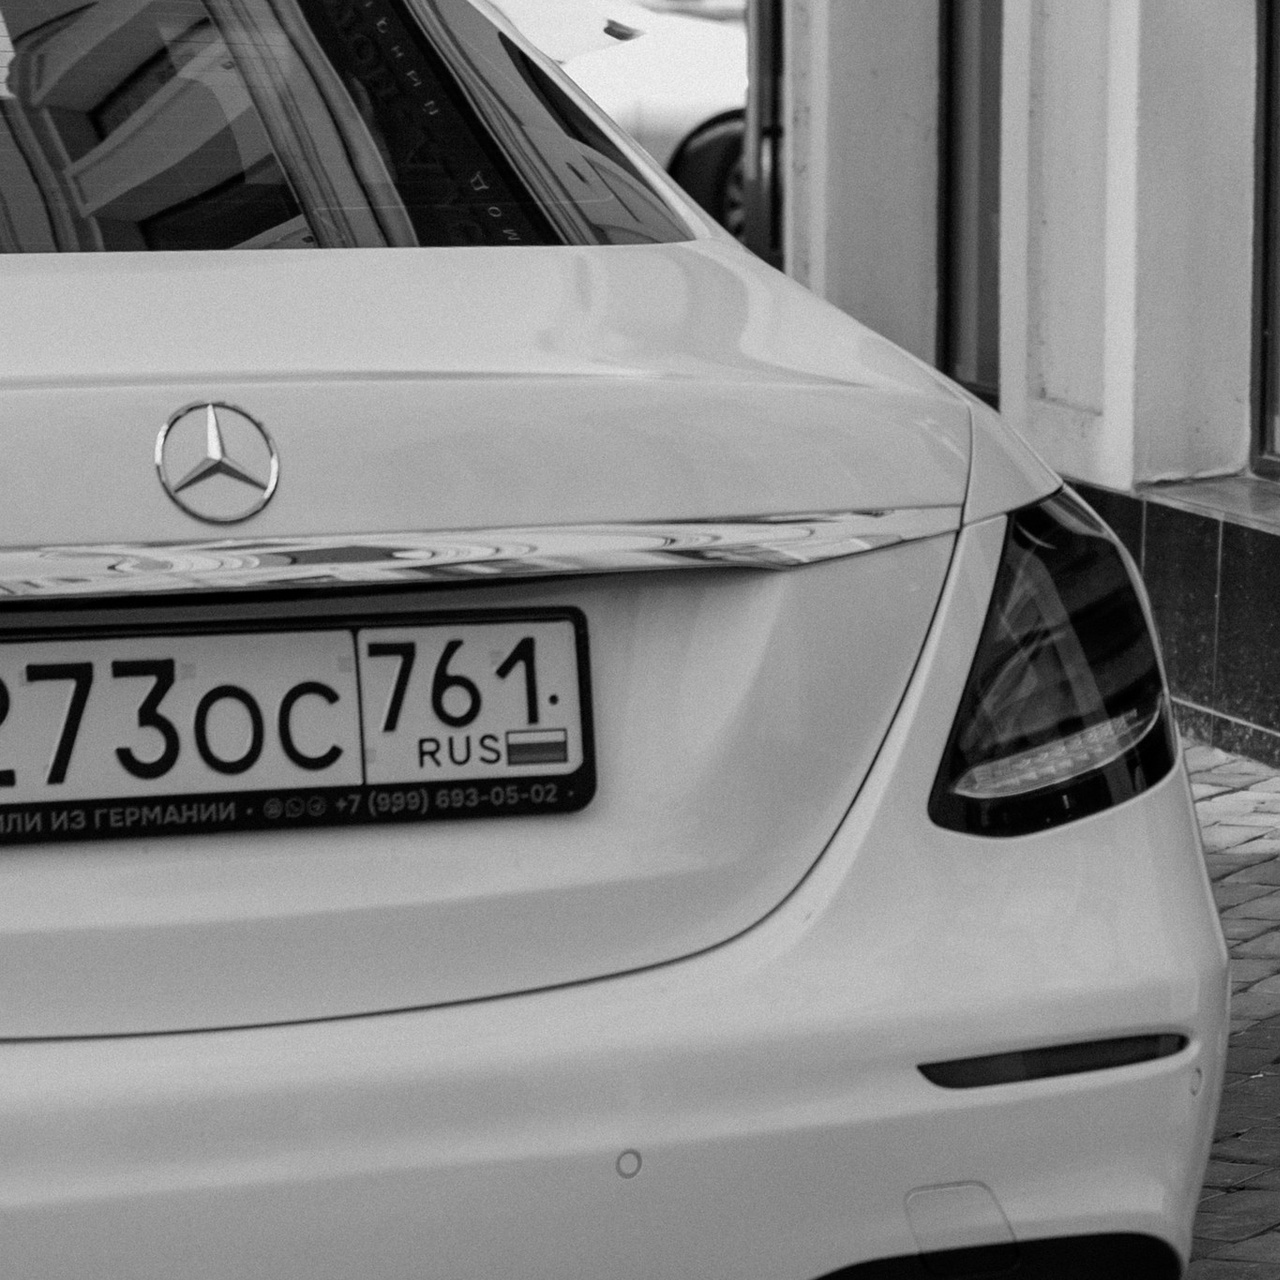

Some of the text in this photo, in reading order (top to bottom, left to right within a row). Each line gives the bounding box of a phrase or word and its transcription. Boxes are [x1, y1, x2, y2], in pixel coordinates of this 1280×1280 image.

[0, 659, 342, 786] 73ОС
[418, 735, 502, 768] RUS
[51, 809, 86, 832] ИЗ
[94, 801, 236, 830] ГЕРМАНИИ
[335, 794, 362, 815] +7
[367, 788, 430, 817] (999)
[435, 783, 558, 809] 693-05-02
